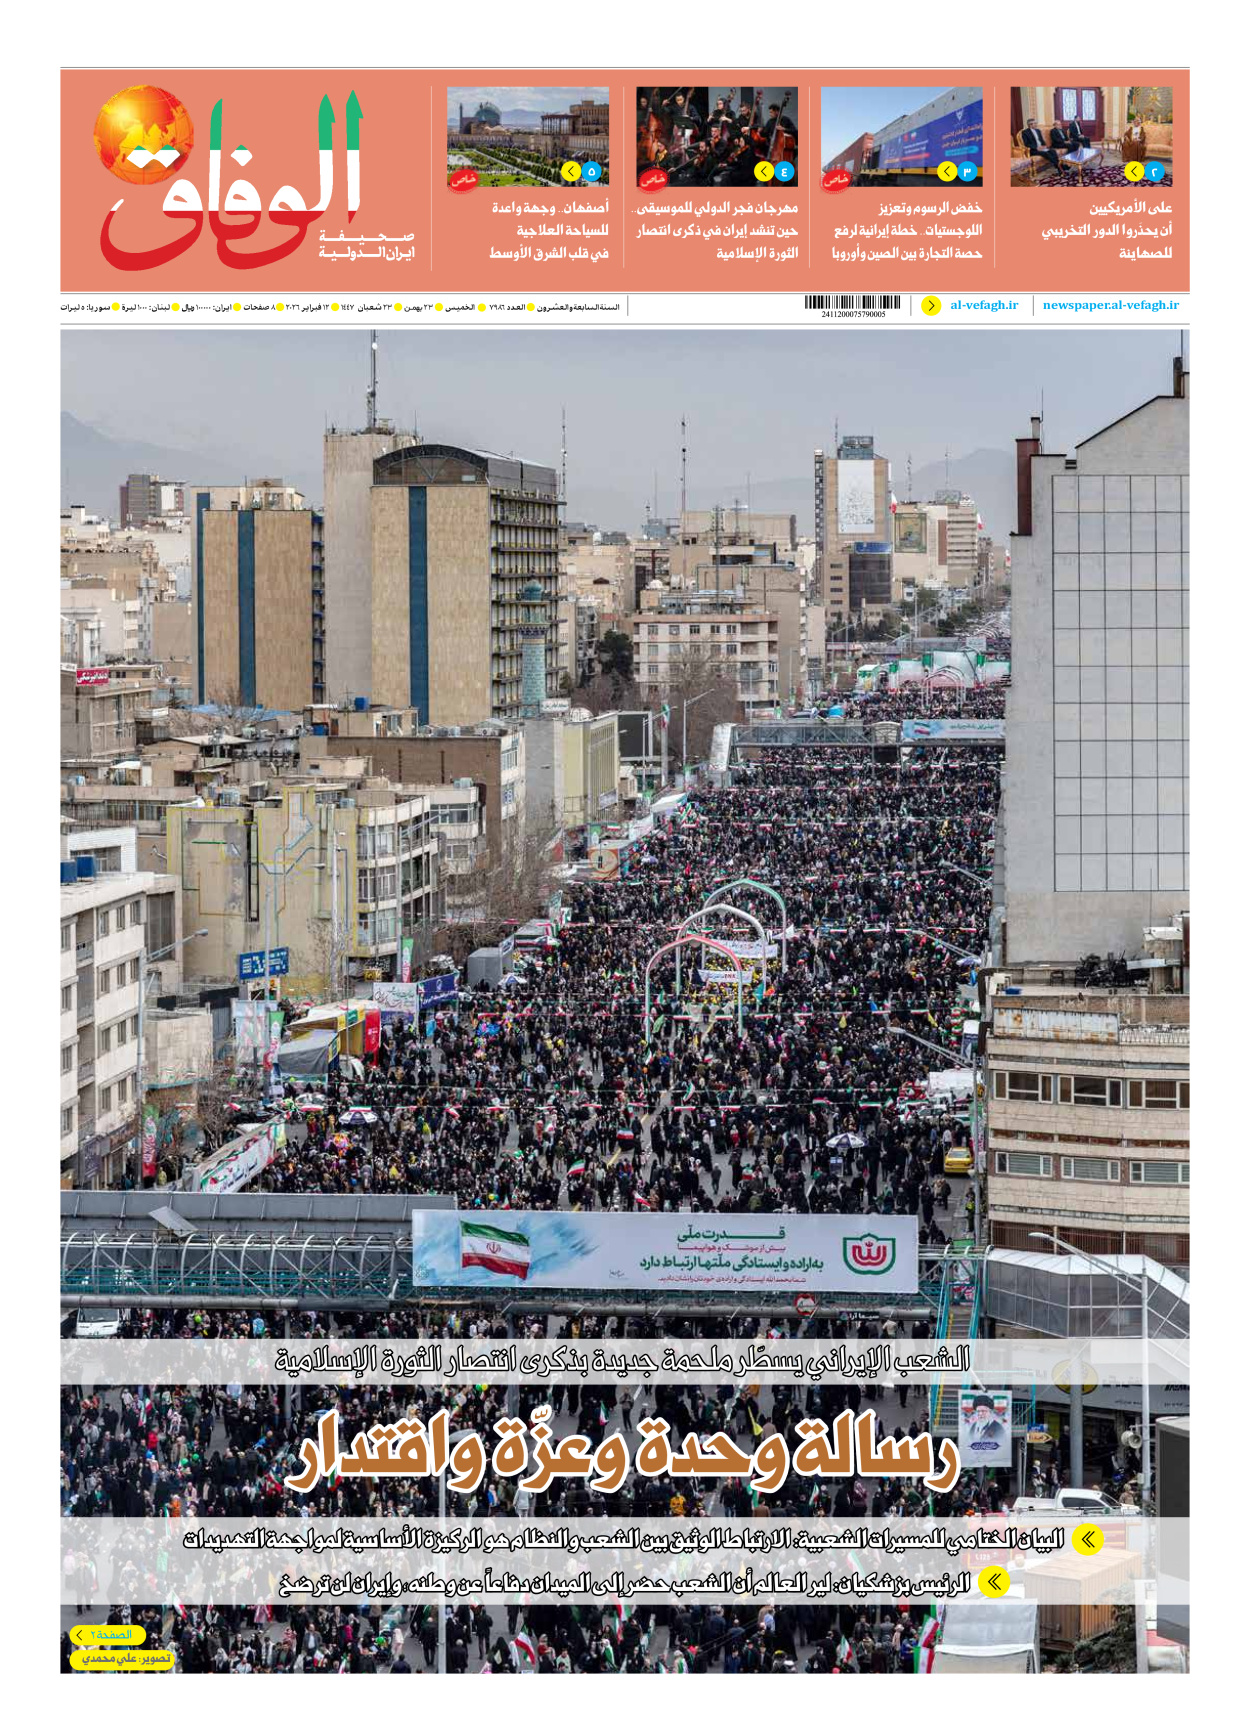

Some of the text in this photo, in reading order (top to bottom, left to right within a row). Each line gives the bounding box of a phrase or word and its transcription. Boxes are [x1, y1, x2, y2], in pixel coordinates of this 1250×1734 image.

[100, 89, 364, 272] الوفاق
[451, 173, 477, 187] خاص
[640, 173, 666, 187] خاص
[823, 173, 849, 187] خاص
[492, 200, 522, 217] واعدة
[523, 202, 556, 217] وجهة
[631, 200, 799, 218] مهرجان فجر الدولي للموسيقى..
[877, 200, 983, 217] خفض الرسوم وتعزيز
[1089, 197, 1173, 217] على الأمريكيين
[318, 229, 416, 244] صحيفة
[516, 223, 609, 239] للسياحة العلاجية
[635, 223, 799, 241] حين تنشد إيران في ذكرى انتصار
[833, 223, 983, 239] اللوجستيات.. خطة إيرانية لرفع
[1041, 220, 1173, 241] أن يحذَروا الدور التخريبي
[318, 245, 386, 262] الدولية
[489, 243, 609, 263] في قلب الشرق الأوسط
[716, 246, 799, 263] الثورة الإسلامية
[831, 243, 983, 262] حصة التجارة بين الصين وأوروبا
[1119, 246, 1173, 262] للصهاينة
[60, 303, 80, 313] ليرات
[86, 303, 111, 313] سوريا:
[121, 303, 137, 313] ليرة
[148, 303, 171, 313] لبنان:
[243, 303, 270, 311] صفحات
[301, 303, 322, 313] فبراير
[357, 303, 382, 313] شعبان
[404, 303, 423, 313] بهمن
[445, 303, 475, 313] الخميس
[506, 303, 526, 311] العدد
[536, 303, 574, 313] والعشرون
[574, 303, 600, 313] السابعة
[599, 303, 620, 311] السنة
[950, 299, 1020, 313] al-vefagh.ir
[1043, 299, 1180, 313] newspaper.al-vefagh.ir
[821, 310, 886, 318] 2411200075790005
[639, 1256, 660, 1271] دارد
[662, 1254, 697, 1271] ارتباط
[733, 1254, 783, 1272] ایستادگی
[790, 1256, 812, 1273] اراده
